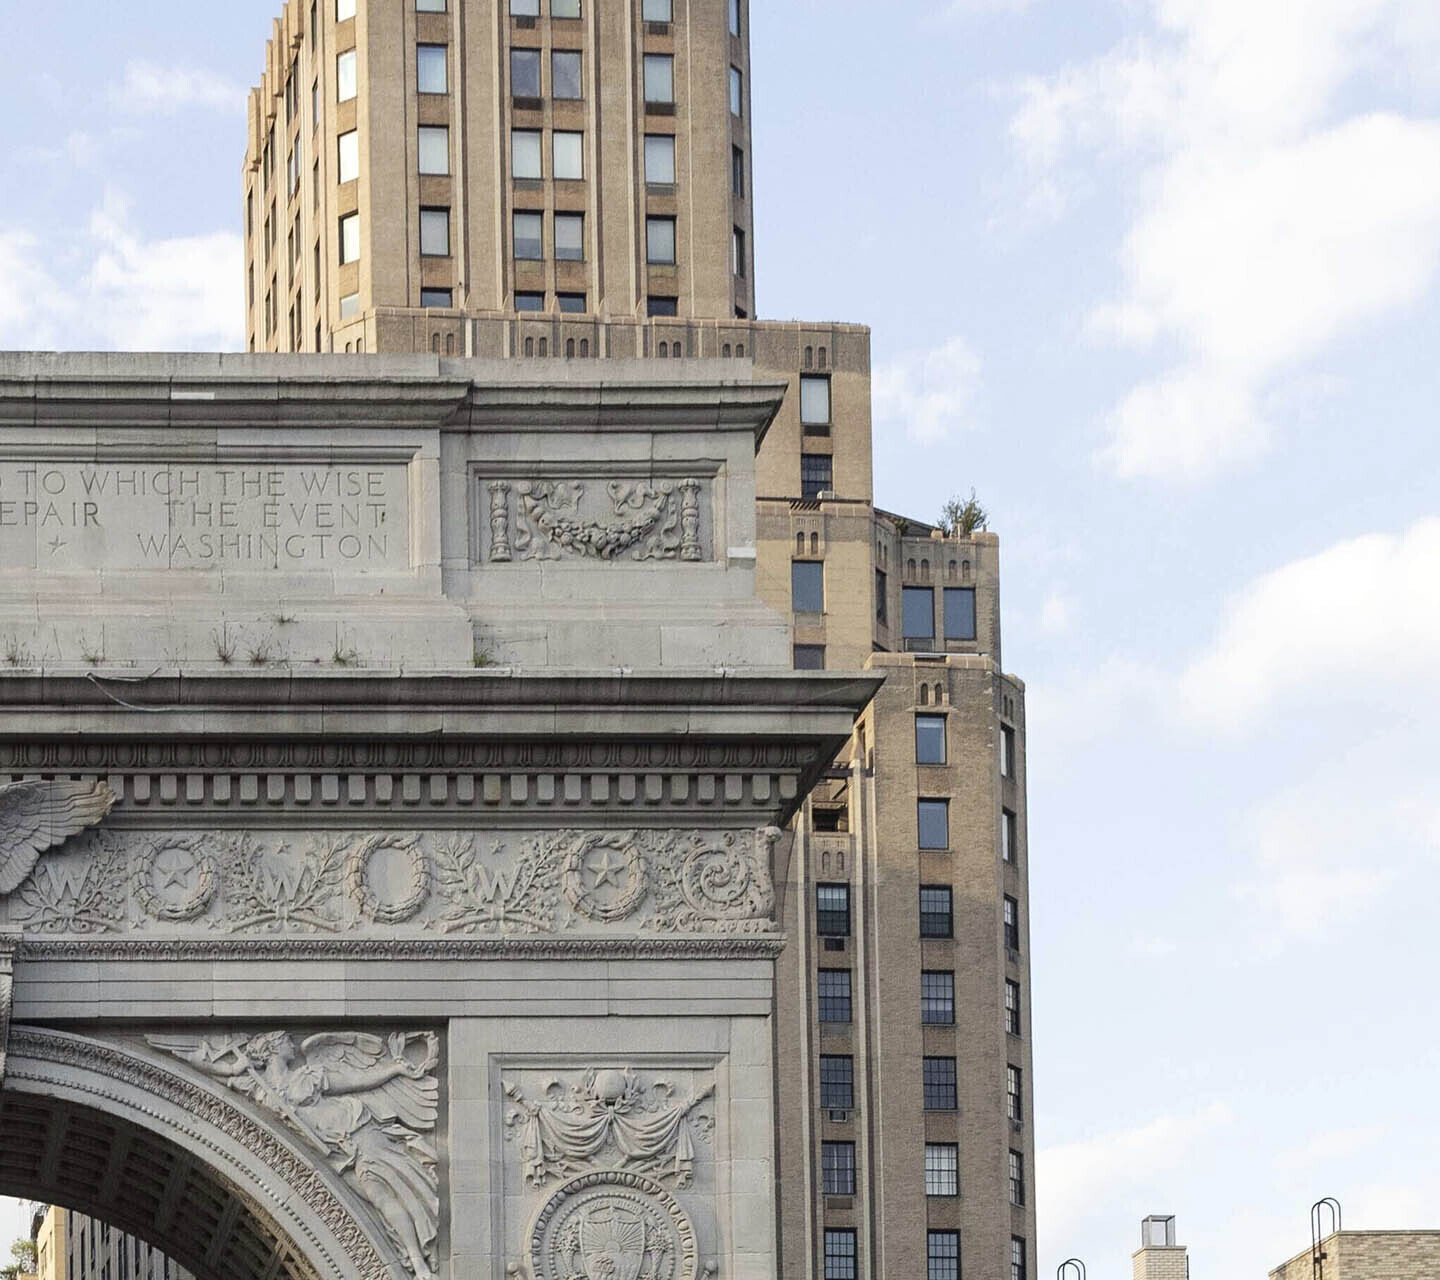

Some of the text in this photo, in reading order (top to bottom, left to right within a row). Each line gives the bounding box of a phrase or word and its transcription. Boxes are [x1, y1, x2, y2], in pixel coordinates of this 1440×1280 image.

[17, 471, 66, 495] TO
[80, 471, 199, 496] WHICH
[217, 472, 286, 496] THE
[301, 472, 386, 496] WISE
[165, 502, 237, 527] THE
[264, 502, 387, 527] EVENT
[138, 534, 387, 559] WASHINGTON
